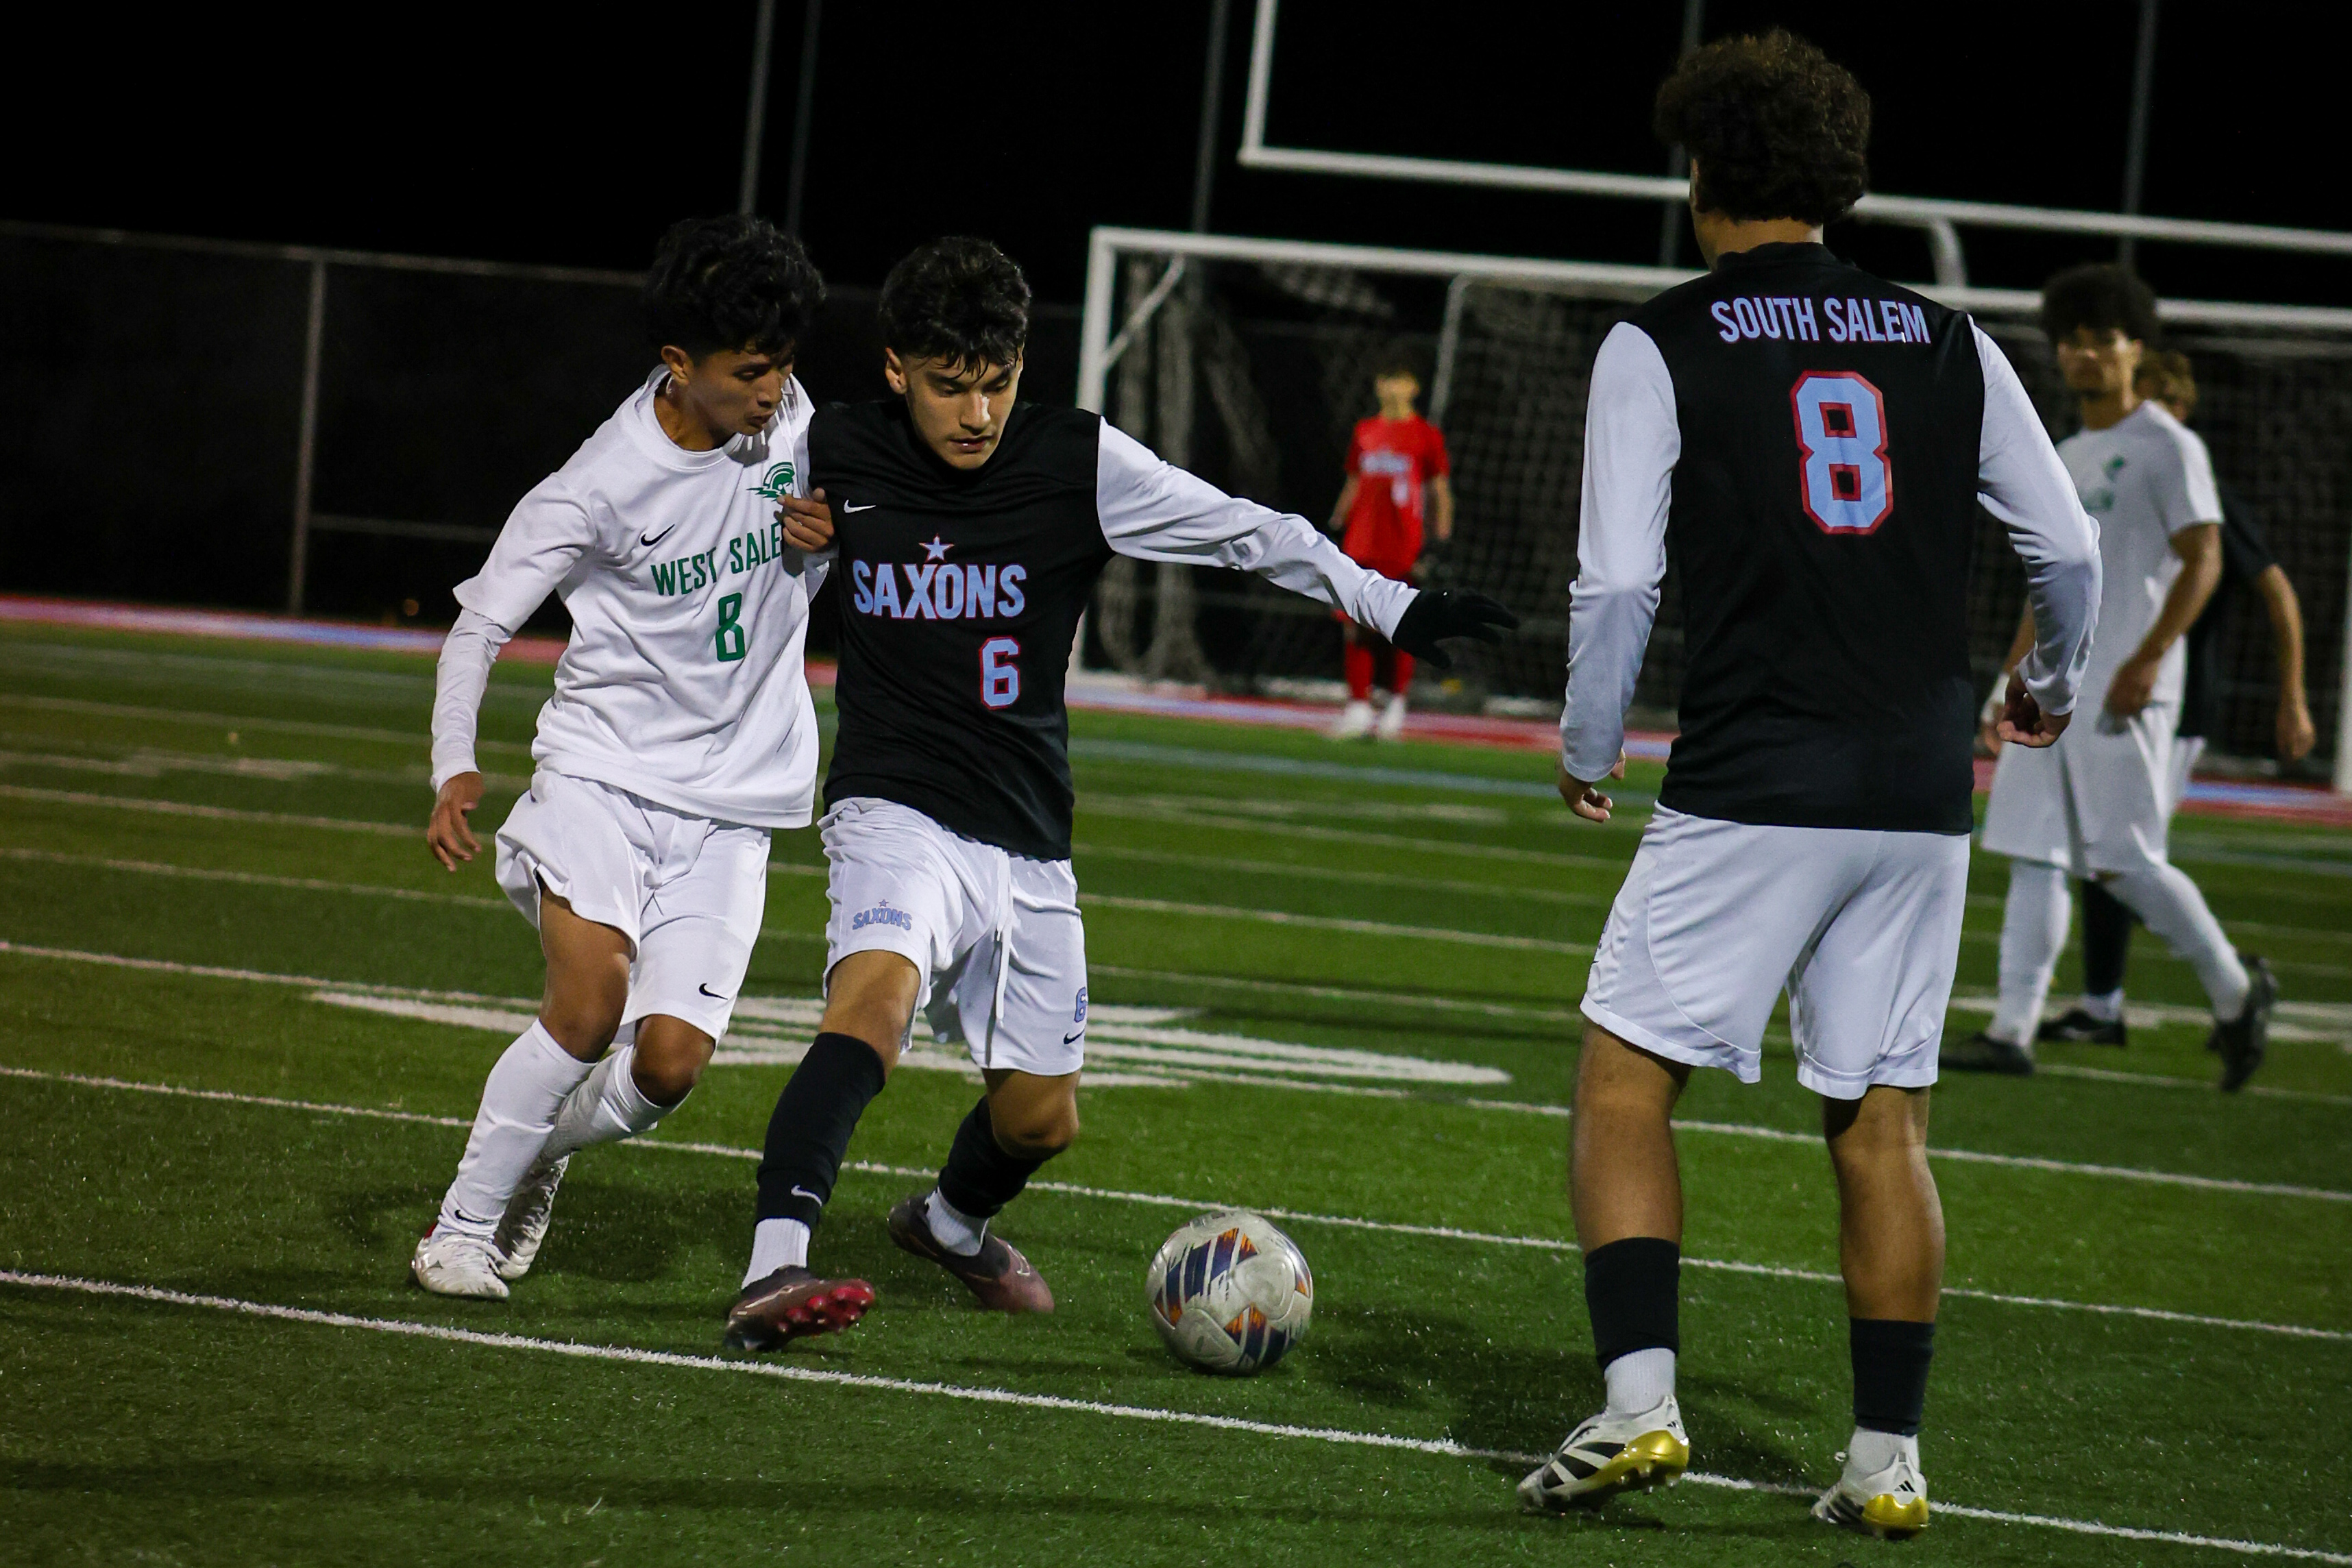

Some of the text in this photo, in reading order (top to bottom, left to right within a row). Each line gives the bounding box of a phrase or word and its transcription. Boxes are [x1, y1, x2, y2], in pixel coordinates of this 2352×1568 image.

[1711, 297, 1931, 343] SOUTH SALEM
[1789, 369, 1894, 535] 8
[650, 522, 781, 596] WEST SALE
[852, 559, 1027, 620] SAXONS
[715, 592, 746, 662] 8
[979, 635, 1021, 710] 6
[852, 907, 913, 931] SAXONS
[1074, 986, 1087, 1023] 6
